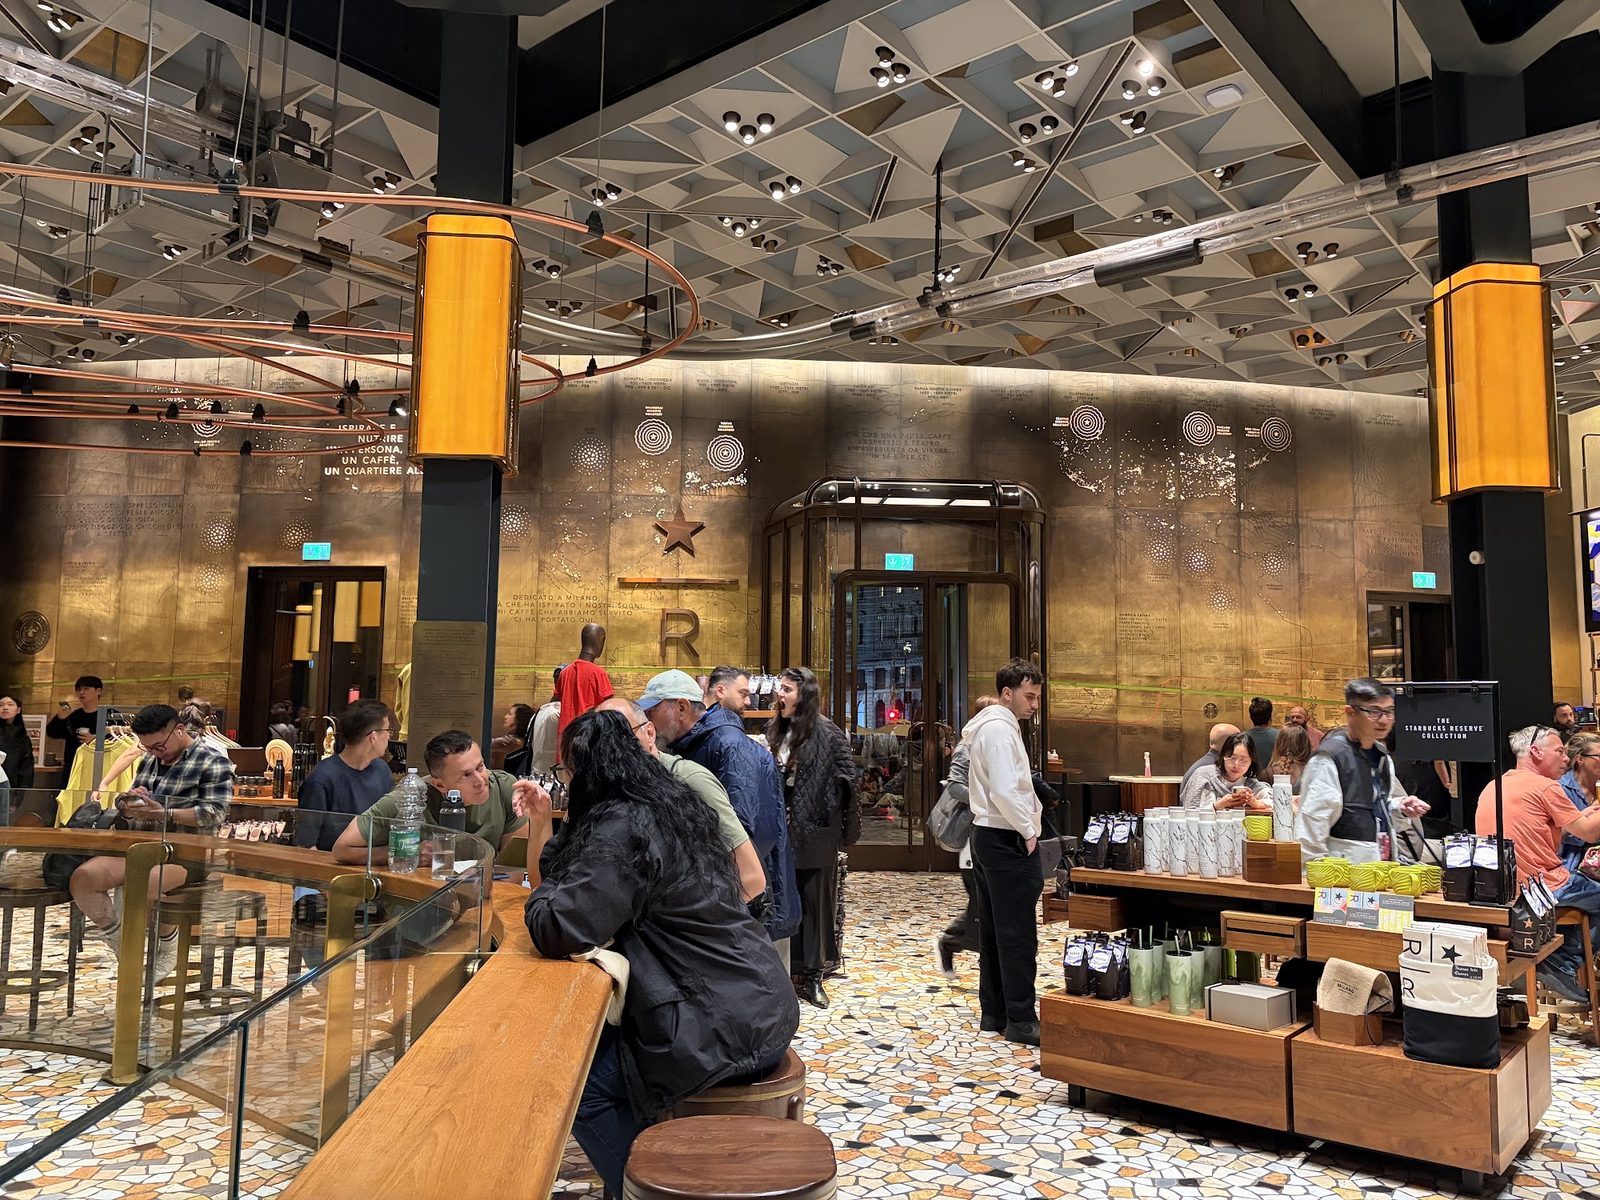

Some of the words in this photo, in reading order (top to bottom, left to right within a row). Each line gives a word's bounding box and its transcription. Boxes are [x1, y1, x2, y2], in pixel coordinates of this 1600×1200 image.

[358, 434, 404, 443] NUTIRE
[351, 446, 403, 454] ERSONA,
[342, 456, 358, 464] UN
[362, 454, 400, 465] CAFFÈ,
[324, 467, 340, 476] UN
[344, 466, 402, 475] QUARTIERE
[660, 608, 700, 657] R
[1524, 938, 1534, 950] R
[1402, 976, 1416, 998] R
